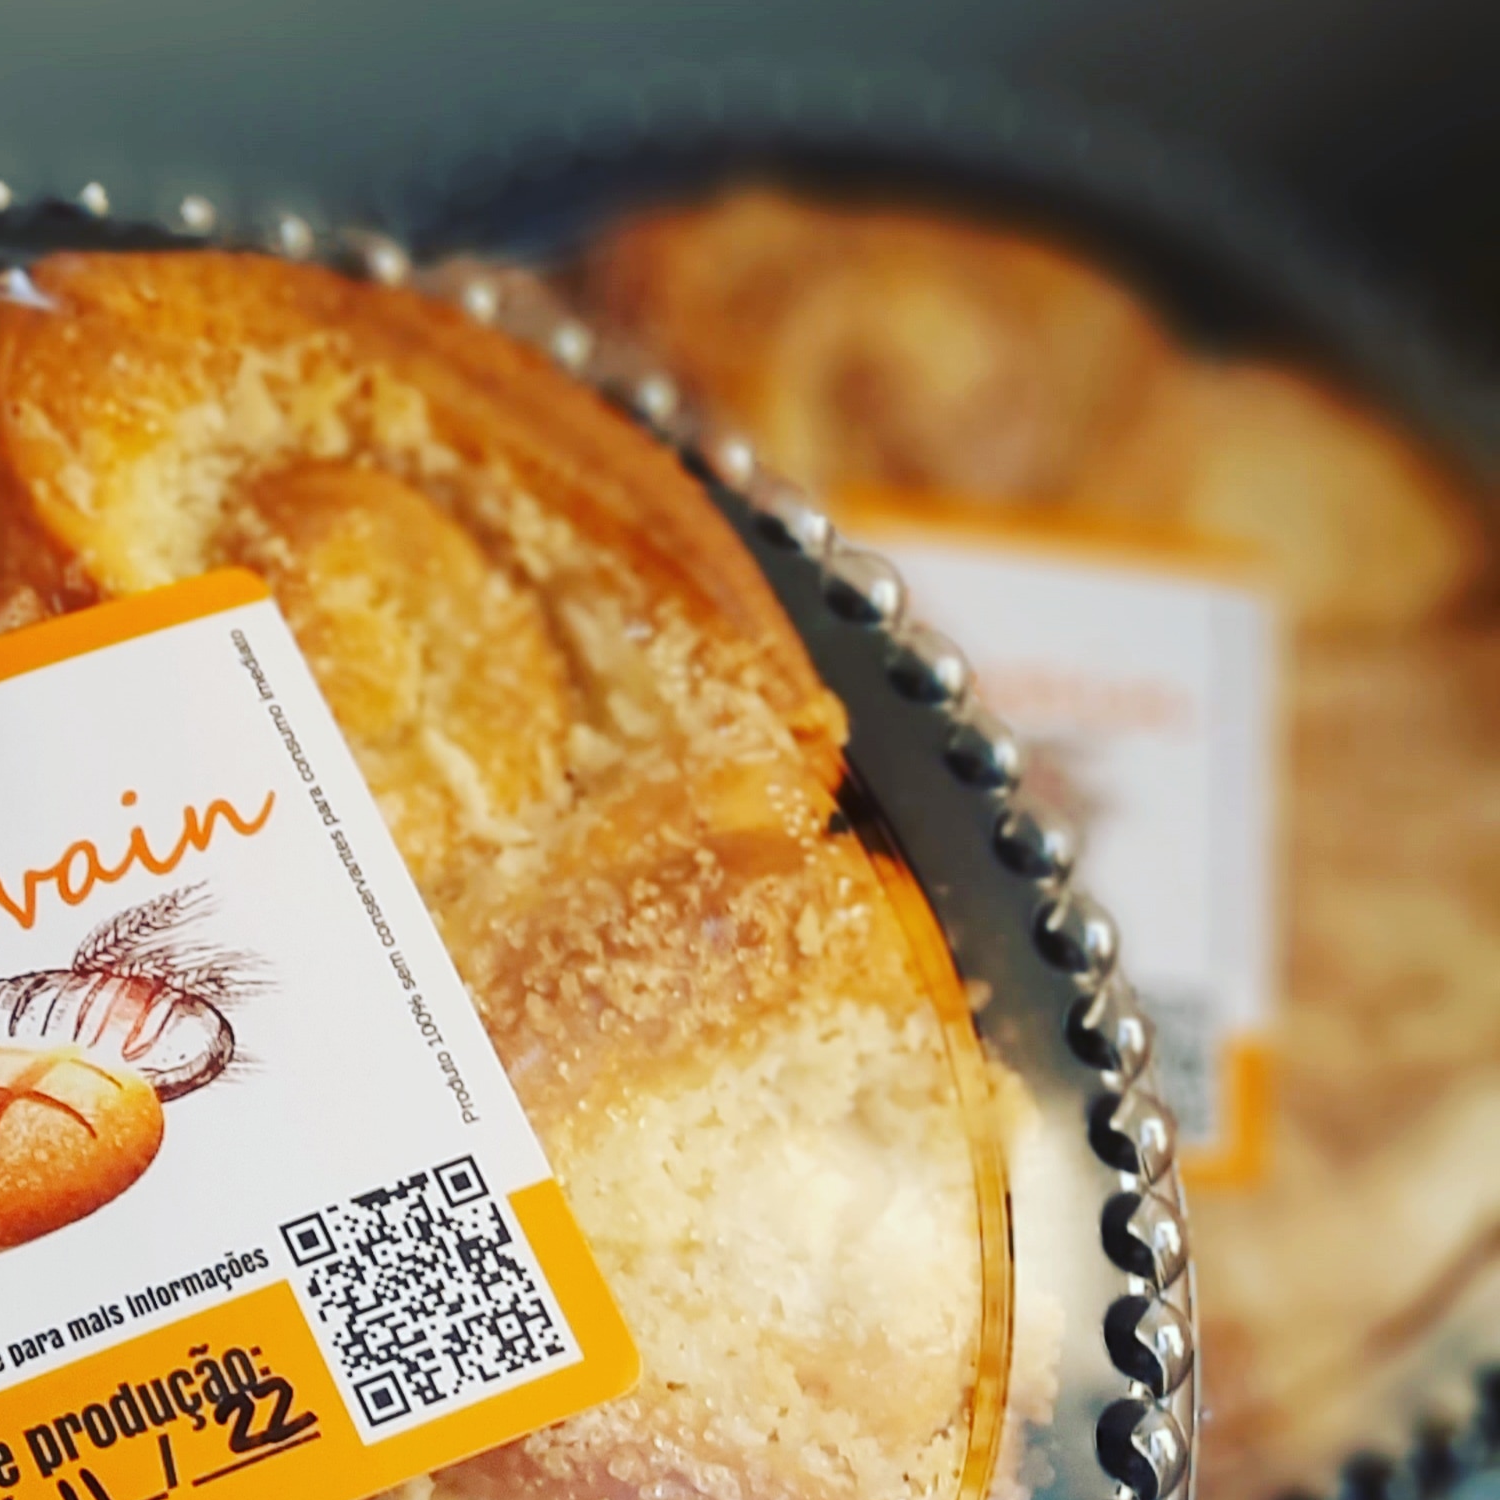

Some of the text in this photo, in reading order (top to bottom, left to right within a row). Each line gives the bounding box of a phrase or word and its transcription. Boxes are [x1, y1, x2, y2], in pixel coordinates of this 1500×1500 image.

[230, 628, 480, 1125] Produto 100% sem conservantes para consumo imediato
[7, 1327, 65, 1368] para
[66, 1304, 125, 1342] mais
[23, 1343, 273, 1479] produção:
[214, 1377, 319, 1453] 22
